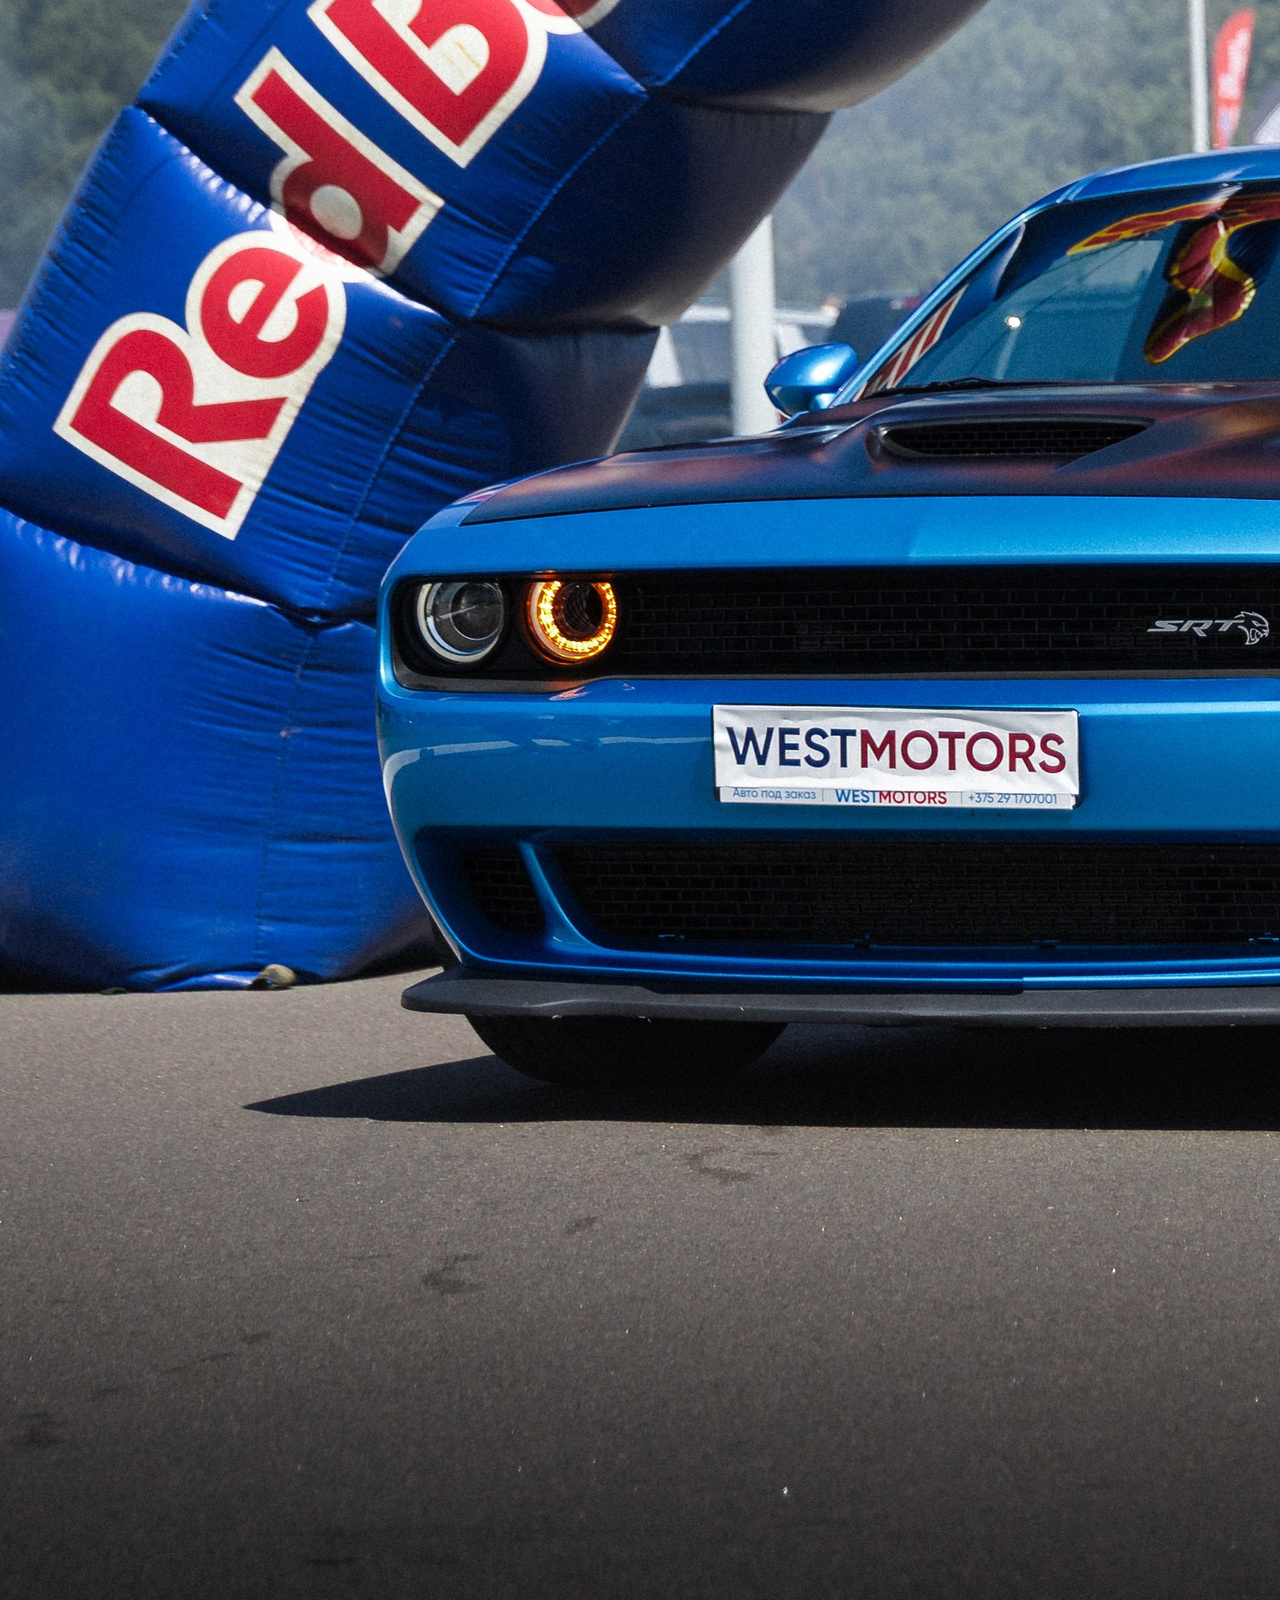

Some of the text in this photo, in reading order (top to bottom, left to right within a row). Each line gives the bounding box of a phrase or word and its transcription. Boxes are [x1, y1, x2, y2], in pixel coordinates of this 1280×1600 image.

[62, 60, 434, 528] Red
[1147, 619, 1245, 637] SRT
[726, 726, 1067, 774] WESTMOTORS
[732, 787, 817, 800] Авто под заказ
[835, 789, 948, 805] WESTMOTORS
[968, 793, 1058, 805] +375 29 1707001
